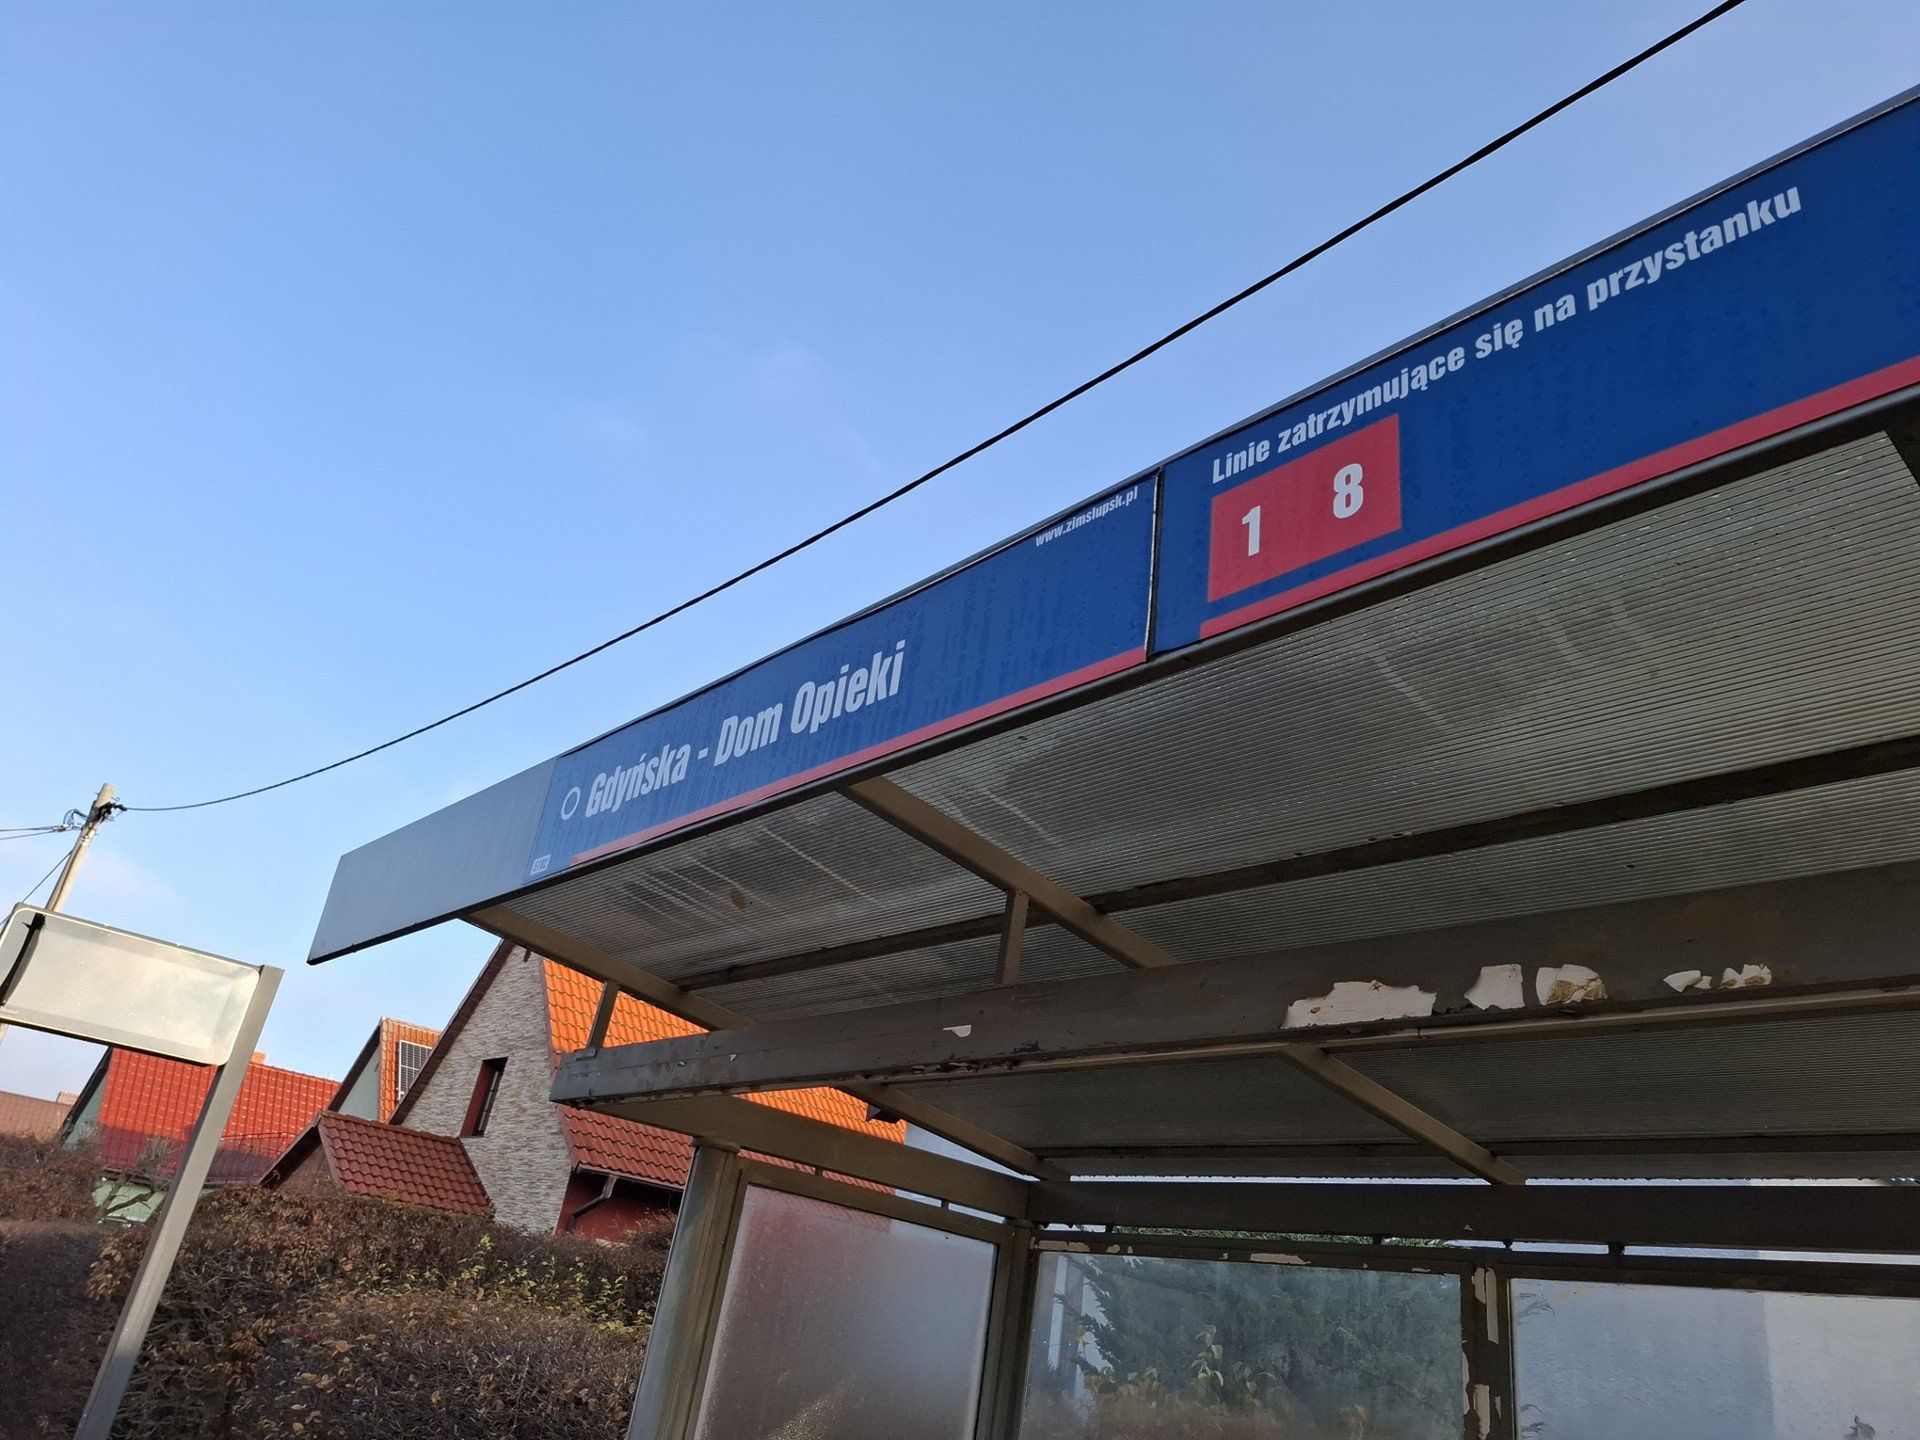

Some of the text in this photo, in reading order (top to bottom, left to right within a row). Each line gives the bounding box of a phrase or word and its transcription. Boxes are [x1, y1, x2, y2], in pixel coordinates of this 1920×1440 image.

[1212, 186, 1802, 484] Linie zatrzymujące się na przystanku
[1035, 485, 1138, 547] www.zimslupsk.pl
[1241, 463, 1364, 557] 1 8
[585, 743, 692, 818] Gdyńska
[713, 702, 783, 767] Dom
[790, 639, 906, 735] Opieki
